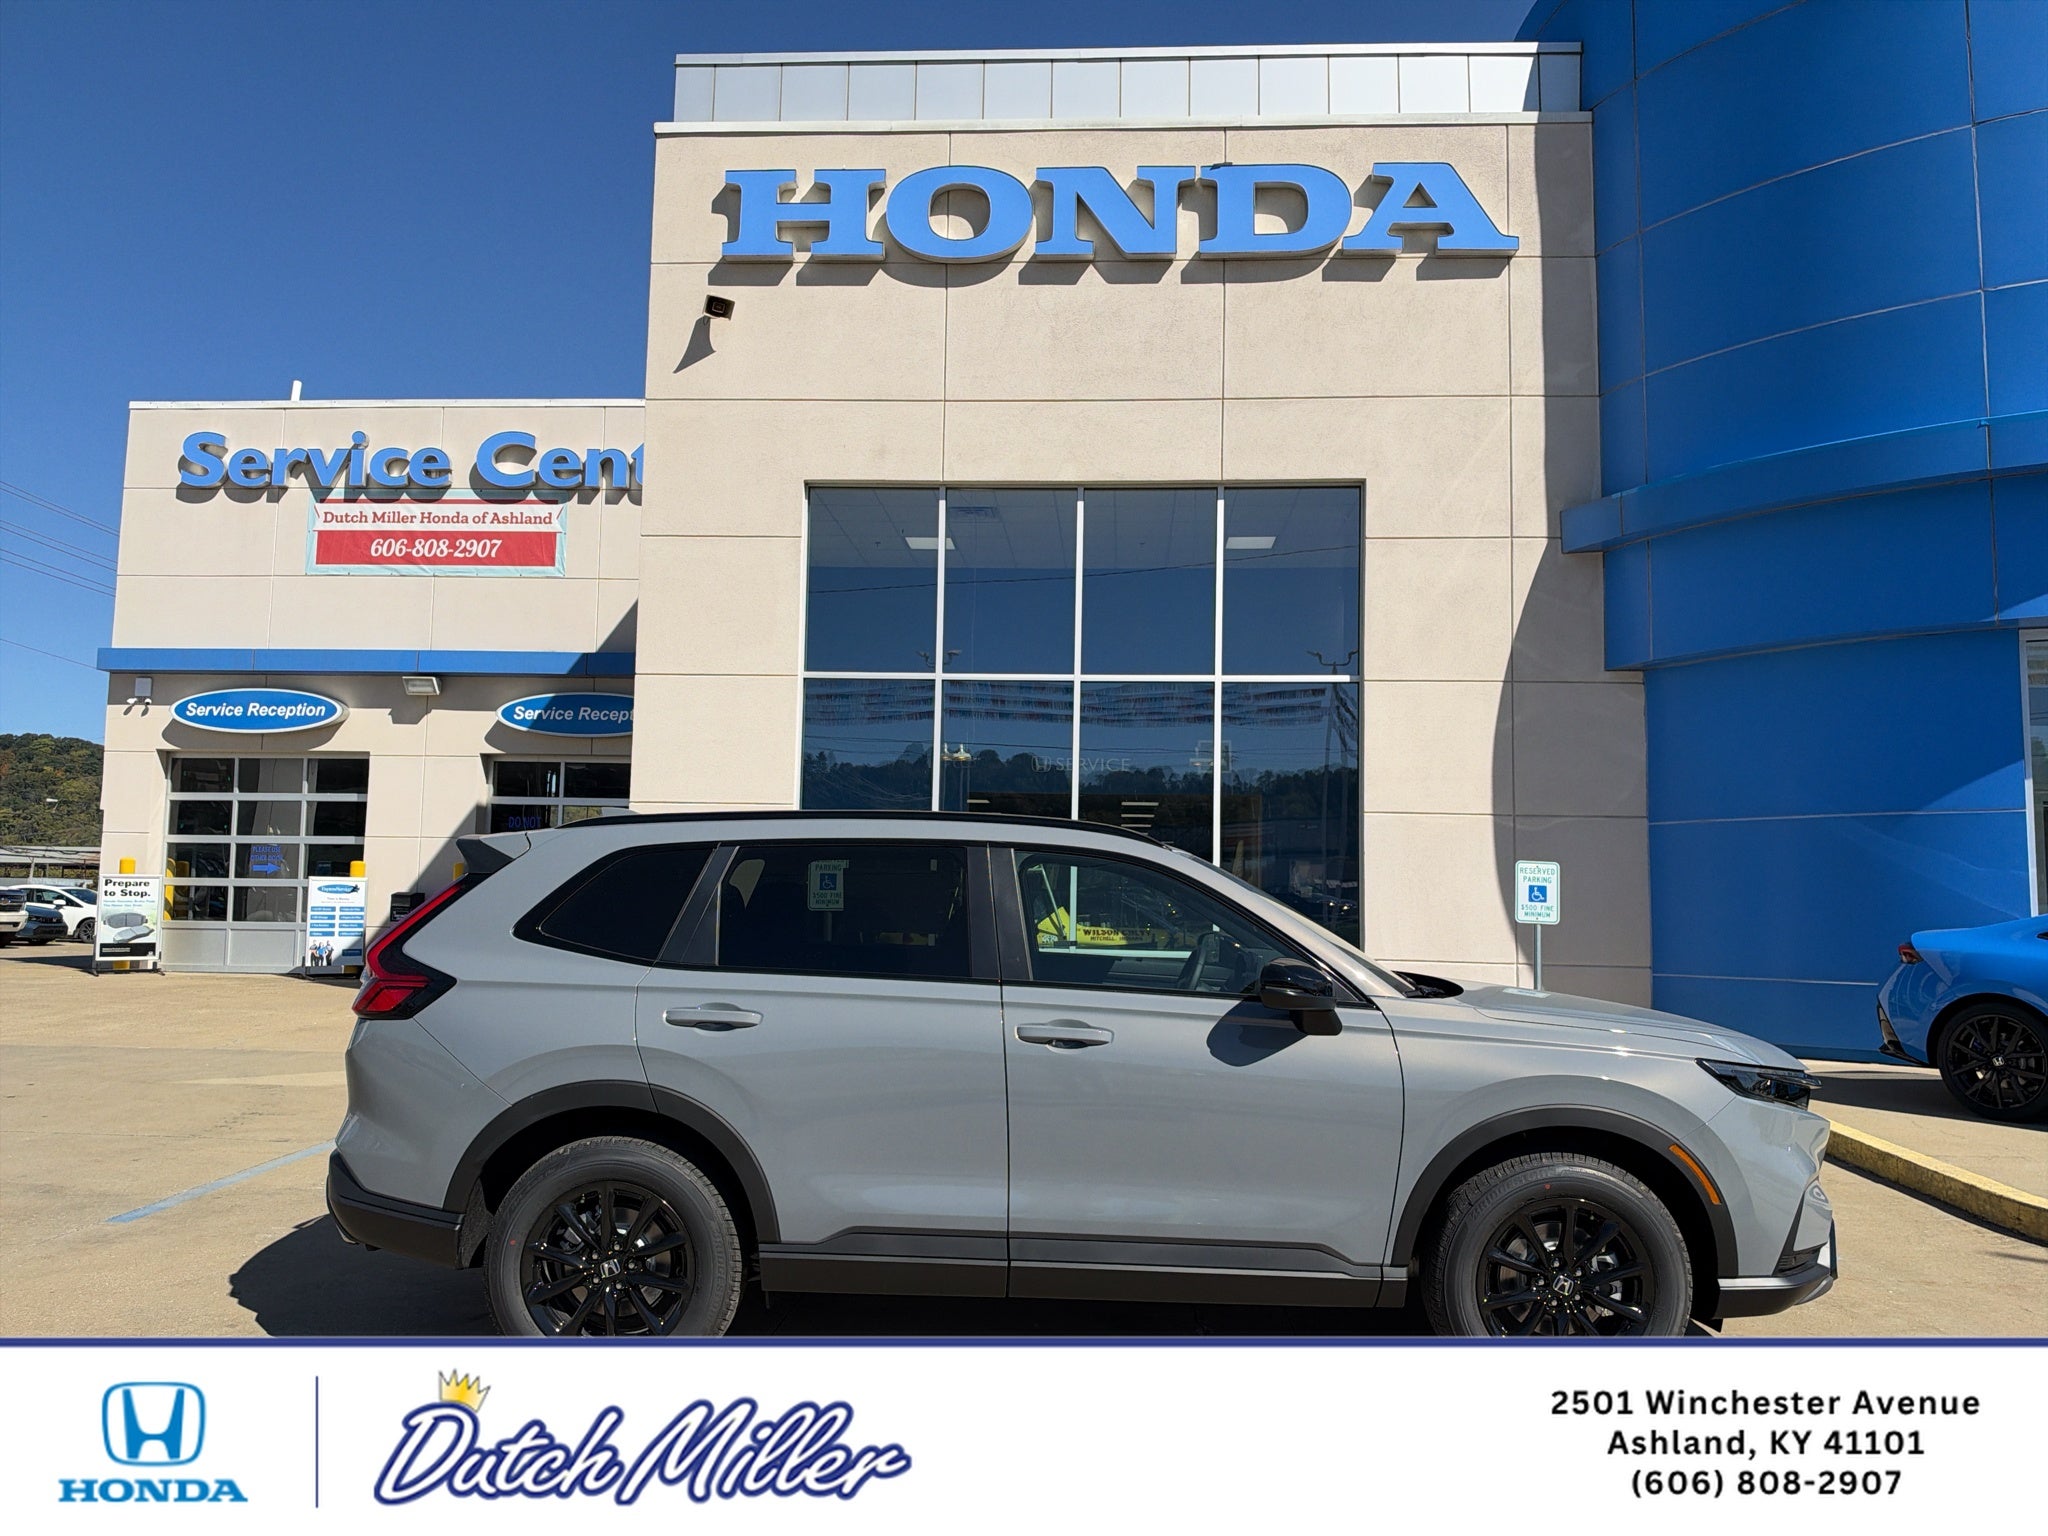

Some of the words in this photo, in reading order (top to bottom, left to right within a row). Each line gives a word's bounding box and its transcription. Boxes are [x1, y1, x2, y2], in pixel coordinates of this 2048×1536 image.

[721, 162, 1519, 263] HONDA
[180, 431, 452, 489] Service
[323, 511, 368, 524] Dutch
[372, 511, 418, 525] Miller
[419, 511, 470, 525] Honda
[472, 511, 488, 525] of
[491, 512, 552, 525] Ashland
[370, 538, 503, 558] 606-808-2907
[186, 702, 244, 717] Service
[247, 702, 326, 719] Reception
[513, 706, 574, 720] Service
[1055, 757, 1131, 772] SERVICE
[508, 816, 521, 829] DO
[523, 816, 541, 829] NOT
[1520, 867, 1556, 876] RESERVED
[104, 879, 150, 889] Prepare
[1523, 876, 1552, 884] PARKING
[120, 889, 151, 898] Stop.
[1083, 928, 1119, 936] WILSON
